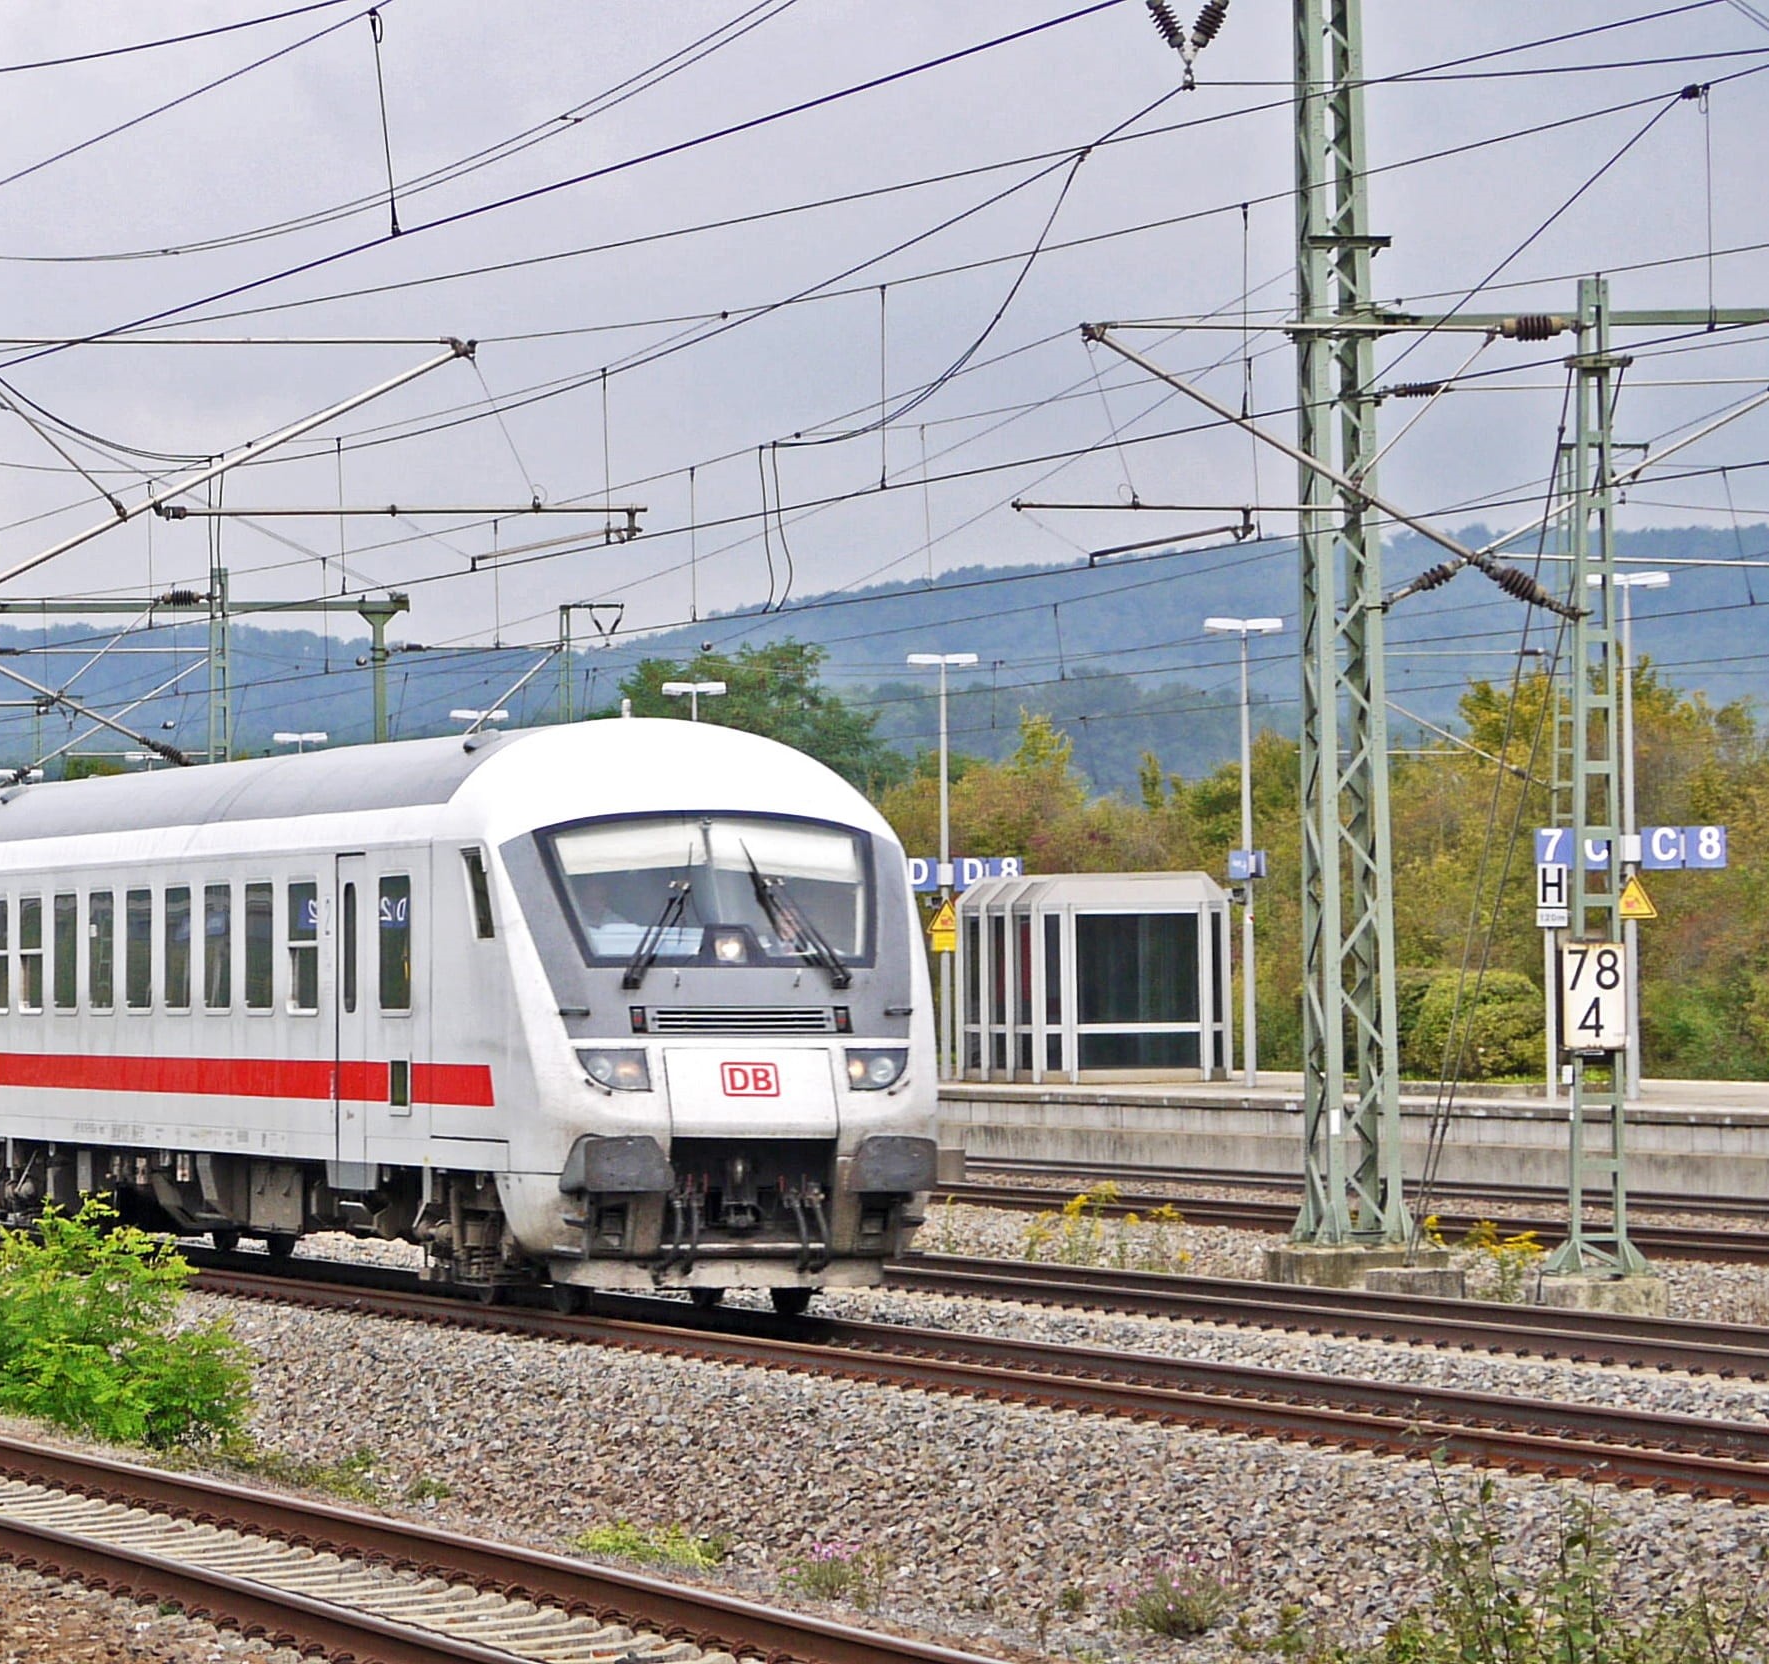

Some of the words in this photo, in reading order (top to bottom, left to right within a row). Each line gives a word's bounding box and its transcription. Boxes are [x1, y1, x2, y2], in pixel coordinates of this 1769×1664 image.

[1541, 828, 1563, 862] 7
[1652, 827, 1678, 861] C
[1698, 826, 1721, 861] 8
[908, 858, 928, 886] D
[963, 858, 983, 886] D
[1542, 868, 1563, 903] H
[1568, 949, 1620, 991] 78
[1578, 997, 1605, 1038] 4
[728, 1067, 773, 1091] DB
